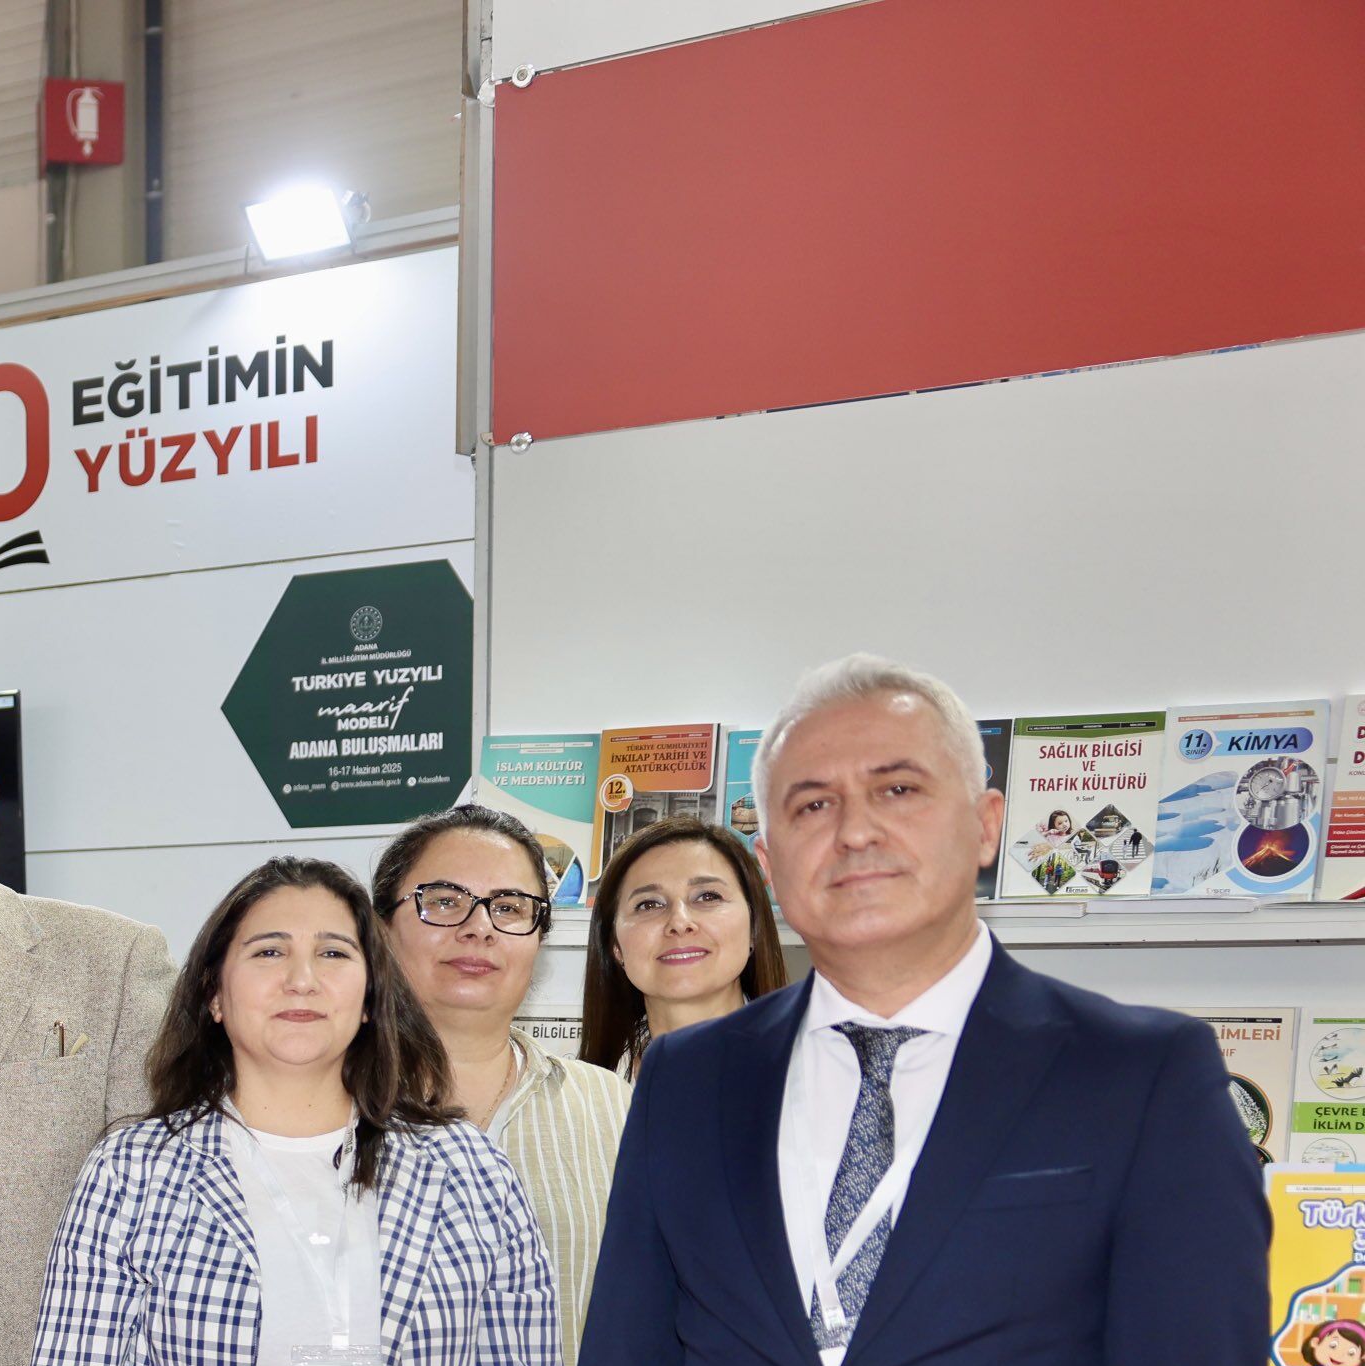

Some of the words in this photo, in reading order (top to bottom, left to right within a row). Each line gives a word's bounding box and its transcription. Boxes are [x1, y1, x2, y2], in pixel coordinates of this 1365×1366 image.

[72, 335, 334, 427] EĞİTİMİN
[74, 415, 319, 493] YÜZYILI
[354, 643, 378, 652] ADANA
[346, 652, 368, 663] EĞİTİM
[369, 649, 411, 661] MÜDÜRLÜĞÜ
[317, 685, 414, 730] maarif
[289, 741, 338, 760] ADANA
[341, 732, 443, 756] BULUŞMALARI
[1184, 732, 1207, 749] 11.
[1227, 731, 1299, 752] KİMYA
[1039, 742, 1089, 759] SAĞLIK
[1091, 739, 1142, 758] BİLGİSİ
[610, 752, 650, 763] İNKILAP
[652, 751, 689, 762] TARİHİ
[693, 751, 707, 761] VE
[328, 766, 352, 776] 16-17
[352, 763, 381, 776] Haziran
[382, 762, 402, 774] 2025
[496, 760, 534, 772] İSLAM
[536, 759, 583, 772] KÜLTÜR
[624, 760, 707, 773] ATATÜRKÇÜLÜK
[1082, 760, 1096, 772] VE
[493, 775, 508, 787] VE
[511, 774, 586, 786] MEDENİYETİ
[608, 780, 627, 795] 12.
[1029, 774, 1078, 792] TRAFİK
[1082, 772, 1147, 790] KÜLTÜRÜ
[1315, 1106, 1358, 1117] ÇEVRE
[1313, 1119, 1351, 1130] İKLİM
